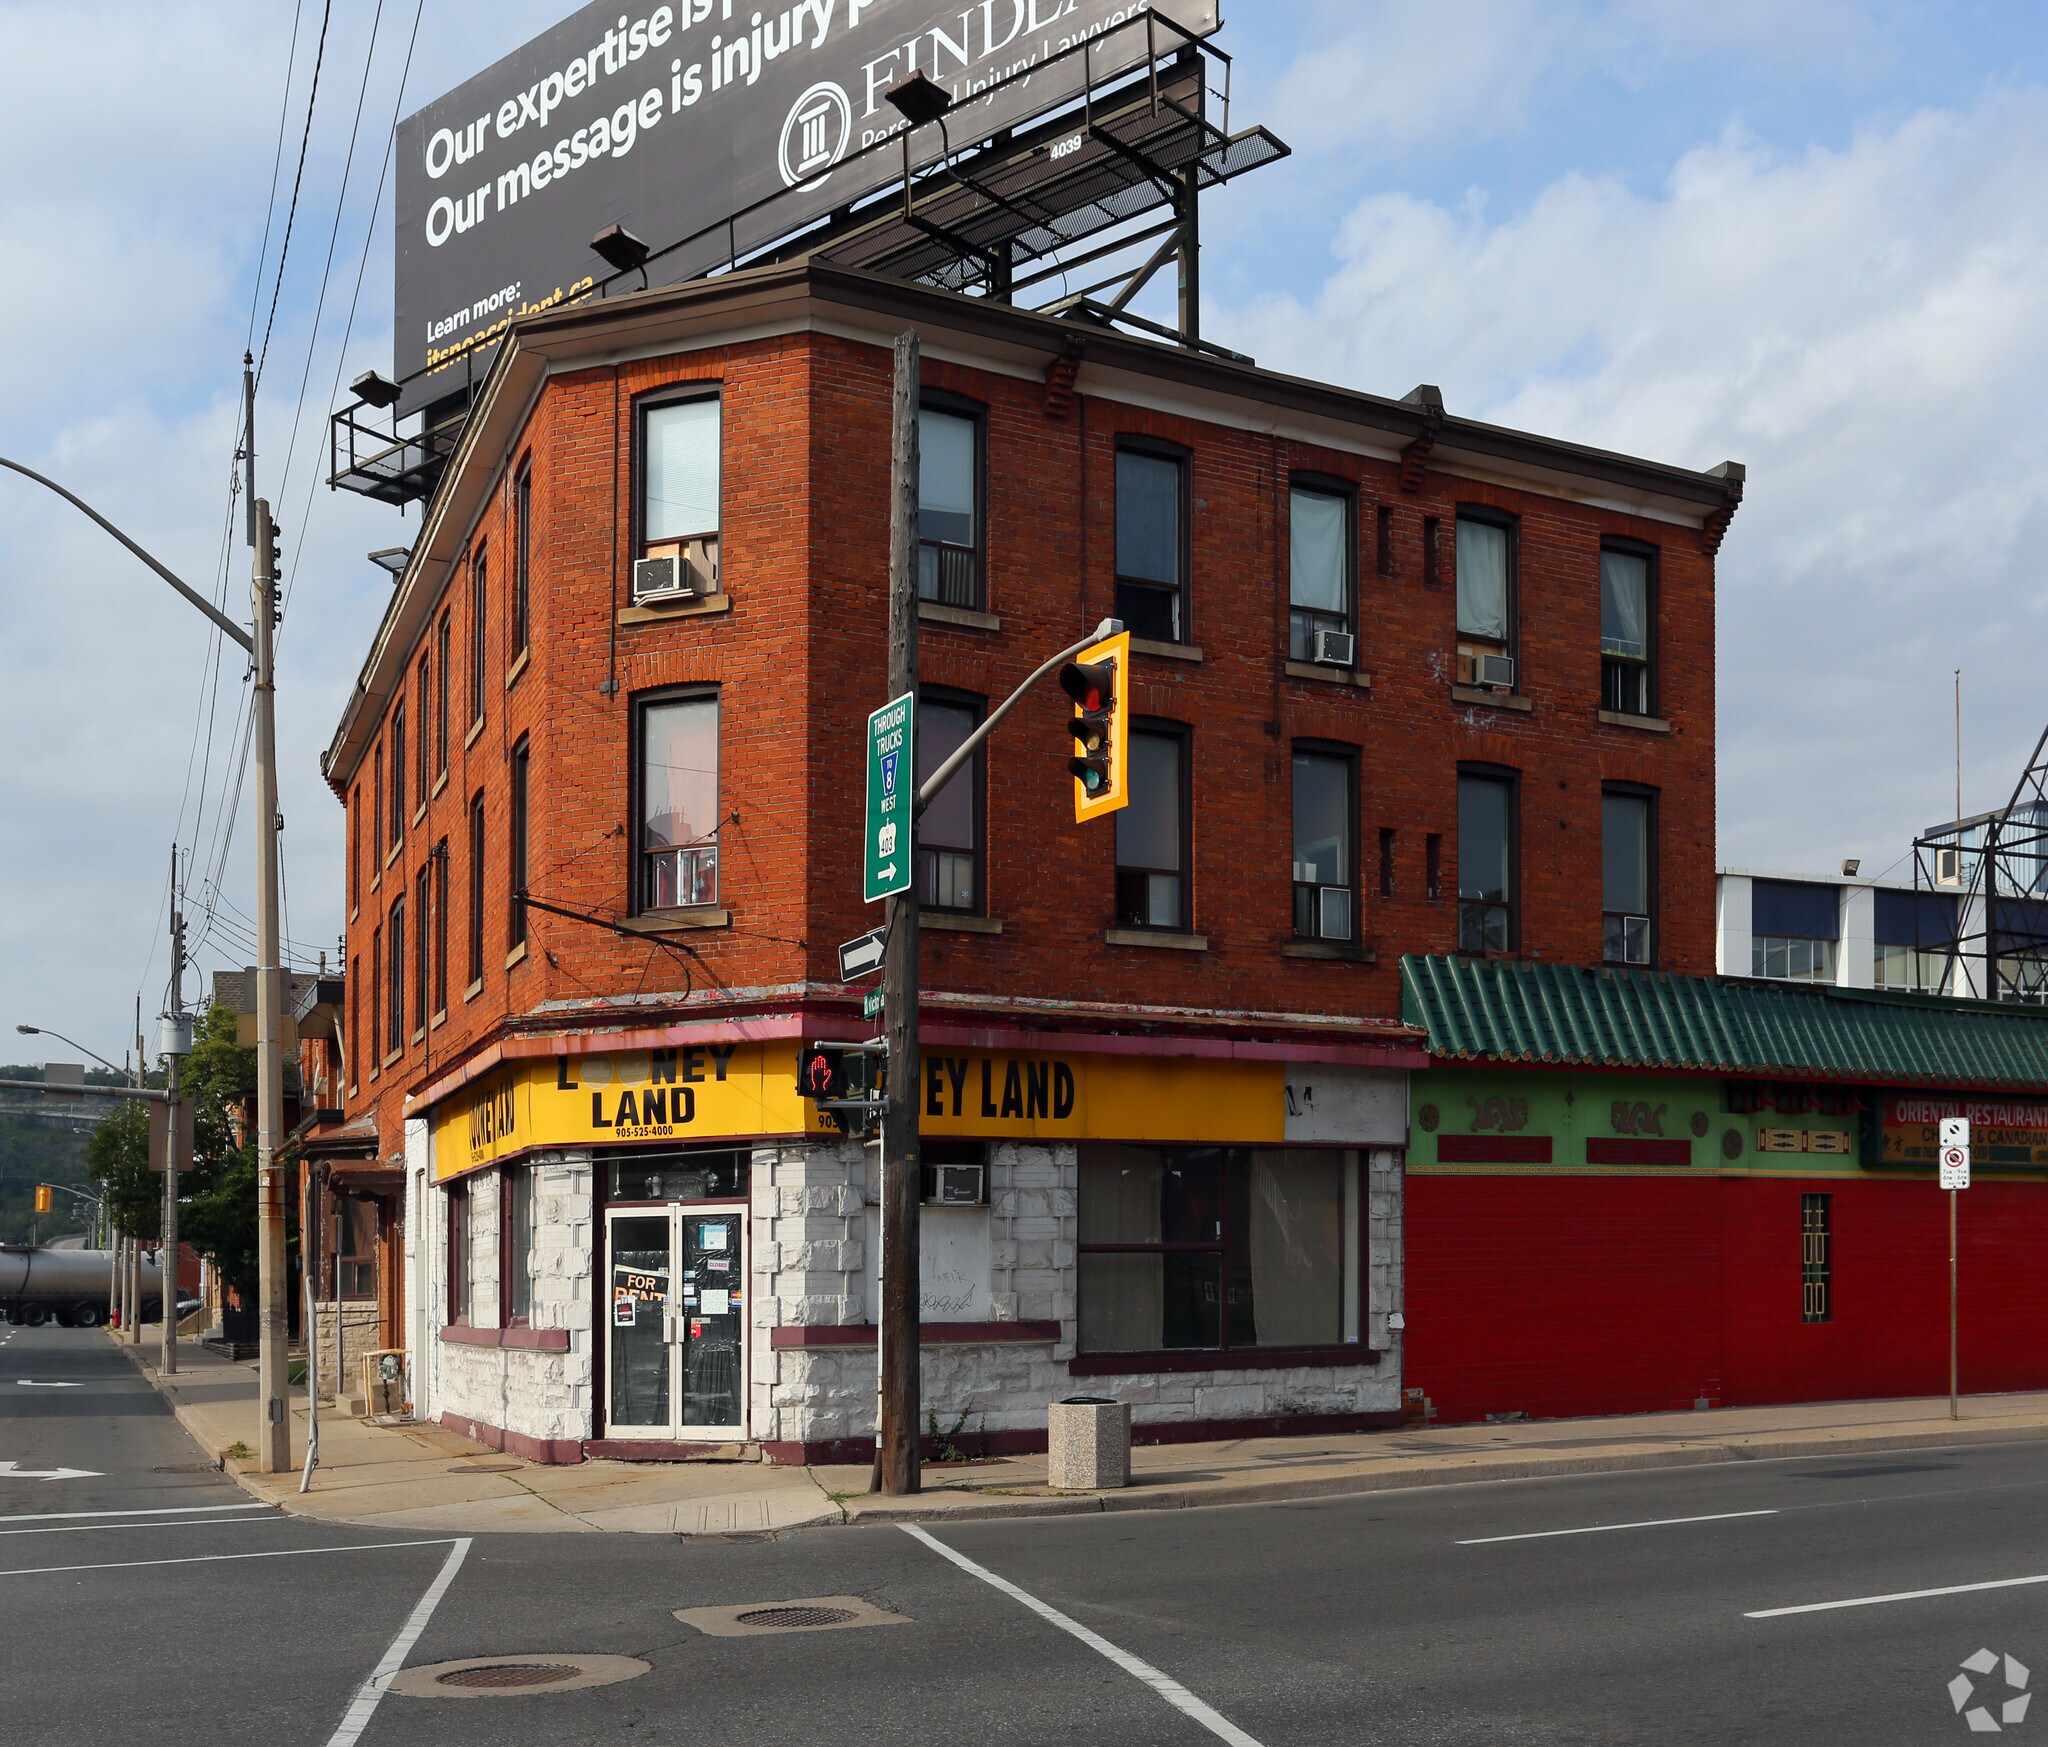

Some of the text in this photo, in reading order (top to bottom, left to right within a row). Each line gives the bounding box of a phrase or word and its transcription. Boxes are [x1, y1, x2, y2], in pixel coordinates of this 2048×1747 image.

[426, 112, 491, 179] Our
[496, 6, 673, 138] expertise
[966, 53, 1037, 108] Injury
[426, 0, 836, 247] Our message is injury
[1050, 135, 1082, 160] 4039
[427, 281, 521, 343] Learn more:
[874, 704, 906, 737] THROUGH
[876, 728, 903, 757] TRUCKS
[886, 759, 893, 770] TO
[886, 771, 892, 789] 8
[881, 795, 897, 814] WEST
[881, 836, 893, 854] 403
[981, 1059, 1075, 1119] LAND
[592, 1087, 695, 1128] LAND
[1896, 1100, 2048, 1127] ORIENTAL RESTAURANT
[616, 1125, 673, 1138] 905-525-4000
[1988, 1130, 2048, 1145] CANADIAN
[627, 1275, 656, 1290] FOR
